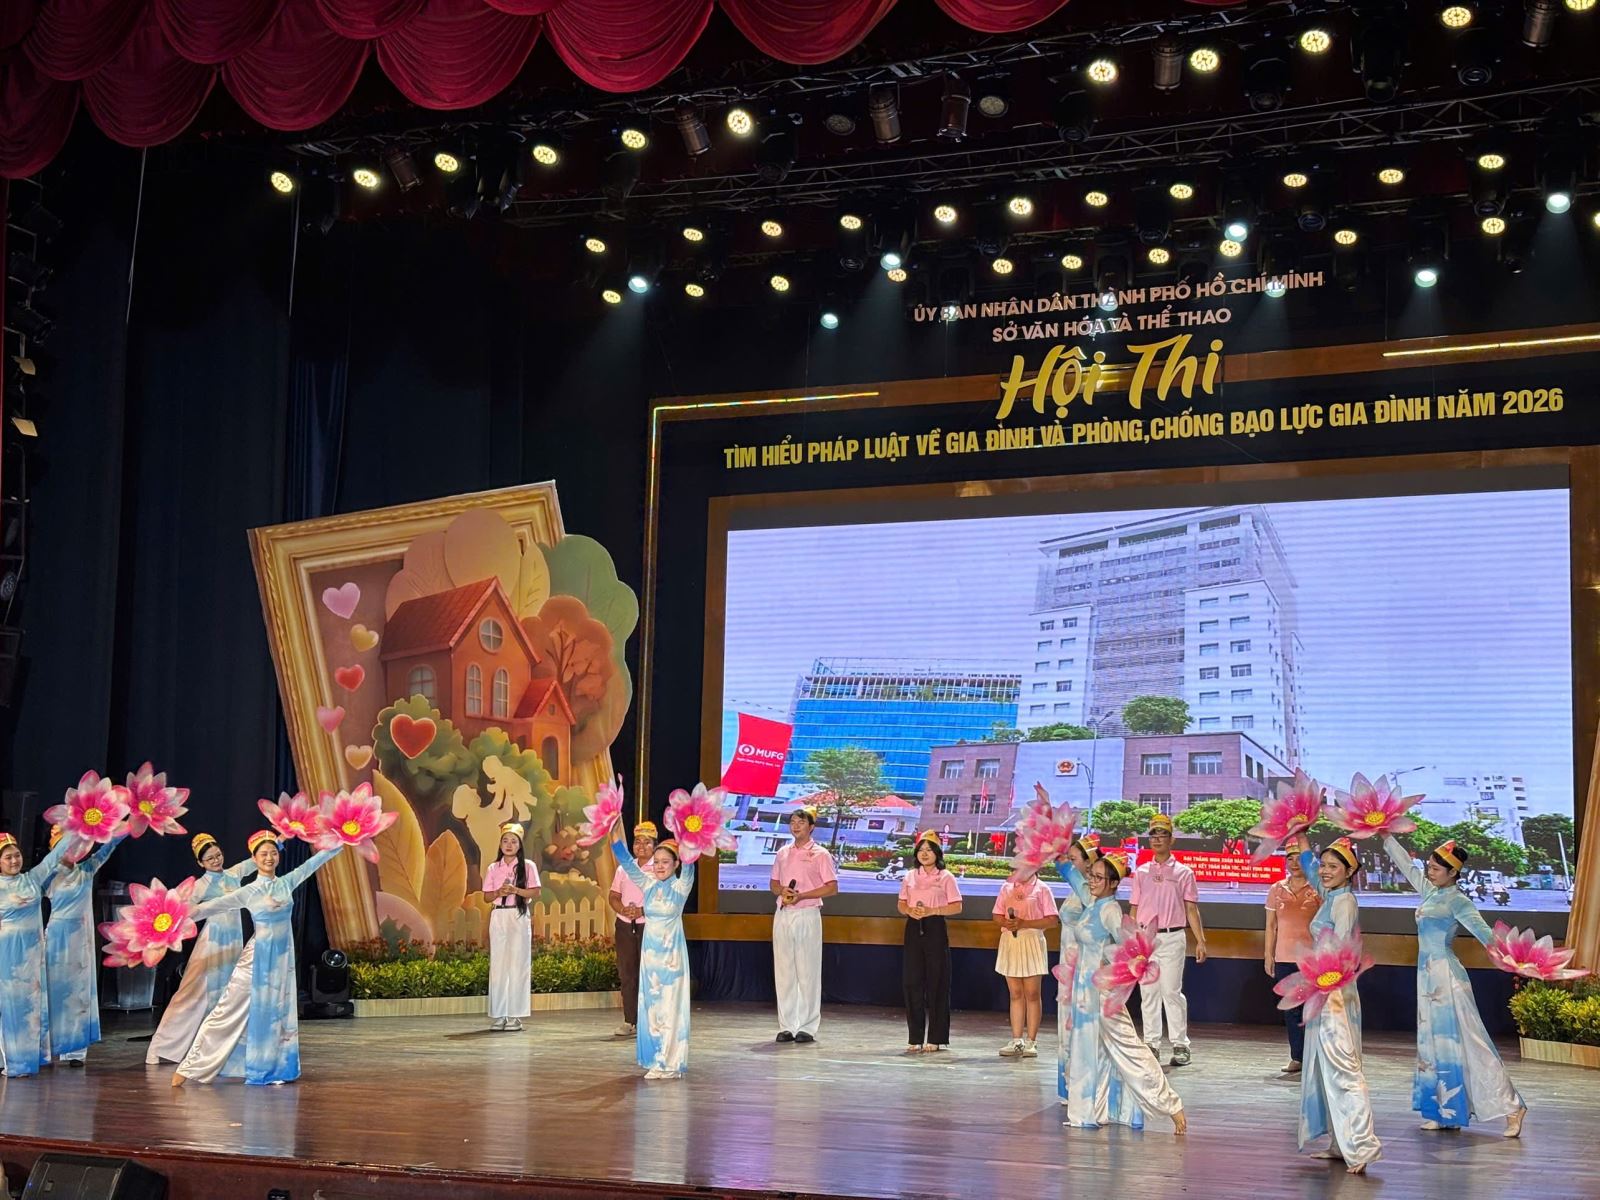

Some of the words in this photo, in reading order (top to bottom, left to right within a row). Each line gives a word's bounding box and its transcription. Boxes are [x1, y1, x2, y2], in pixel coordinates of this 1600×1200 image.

[914, 304, 938, 322] ỦY
[940, 303, 977, 321] BAN
[981, 297, 1033, 317] NHÂN
[1037, 292, 1077, 313] DÂN
[1081, 287, 1146, 309] THÀNH
[1150, 275, 1192, 302] PHỐ
[1196, 272, 1226, 297] HỒ
[1231, 272, 1267, 294] CHÍ
[993, 321, 1018, 342] SỞ
[1022, 321, 1058, 339] VĂN
[1064, 315, 1106, 336] HÓA
[1108, 312, 1133, 332] VÀ
[1137, 305, 1170, 329] THỂ
[1177, 308, 1232, 327] THAO
[996, 344, 1106, 419] Hội
[1126, 333, 1224, 409] Thi
[724, 446, 757, 469] TÌM
[762, 435, 803, 466] HIỂU
[807, 437, 859, 463] PHÁP
[864, 432, 910, 462] LUẬT
[916, 428, 943, 456] VỀ
[946, 431, 979, 454] GIA
[985, 424, 1034, 450] ĐÌNH
[1041, 419, 1065, 447] VÀ
[1230, 409, 1274, 438] BẠO
[1280, 403, 1323, 435] LỰC
[1329, 402, 1368, 428] GIA
[1374, 395, 1431, 423] ĐÌNH
[1437, 388, 1496, 419] NĂM
[1502, 387, 1564, 415] 2026
[756, 749, 784, 760] MUFG
